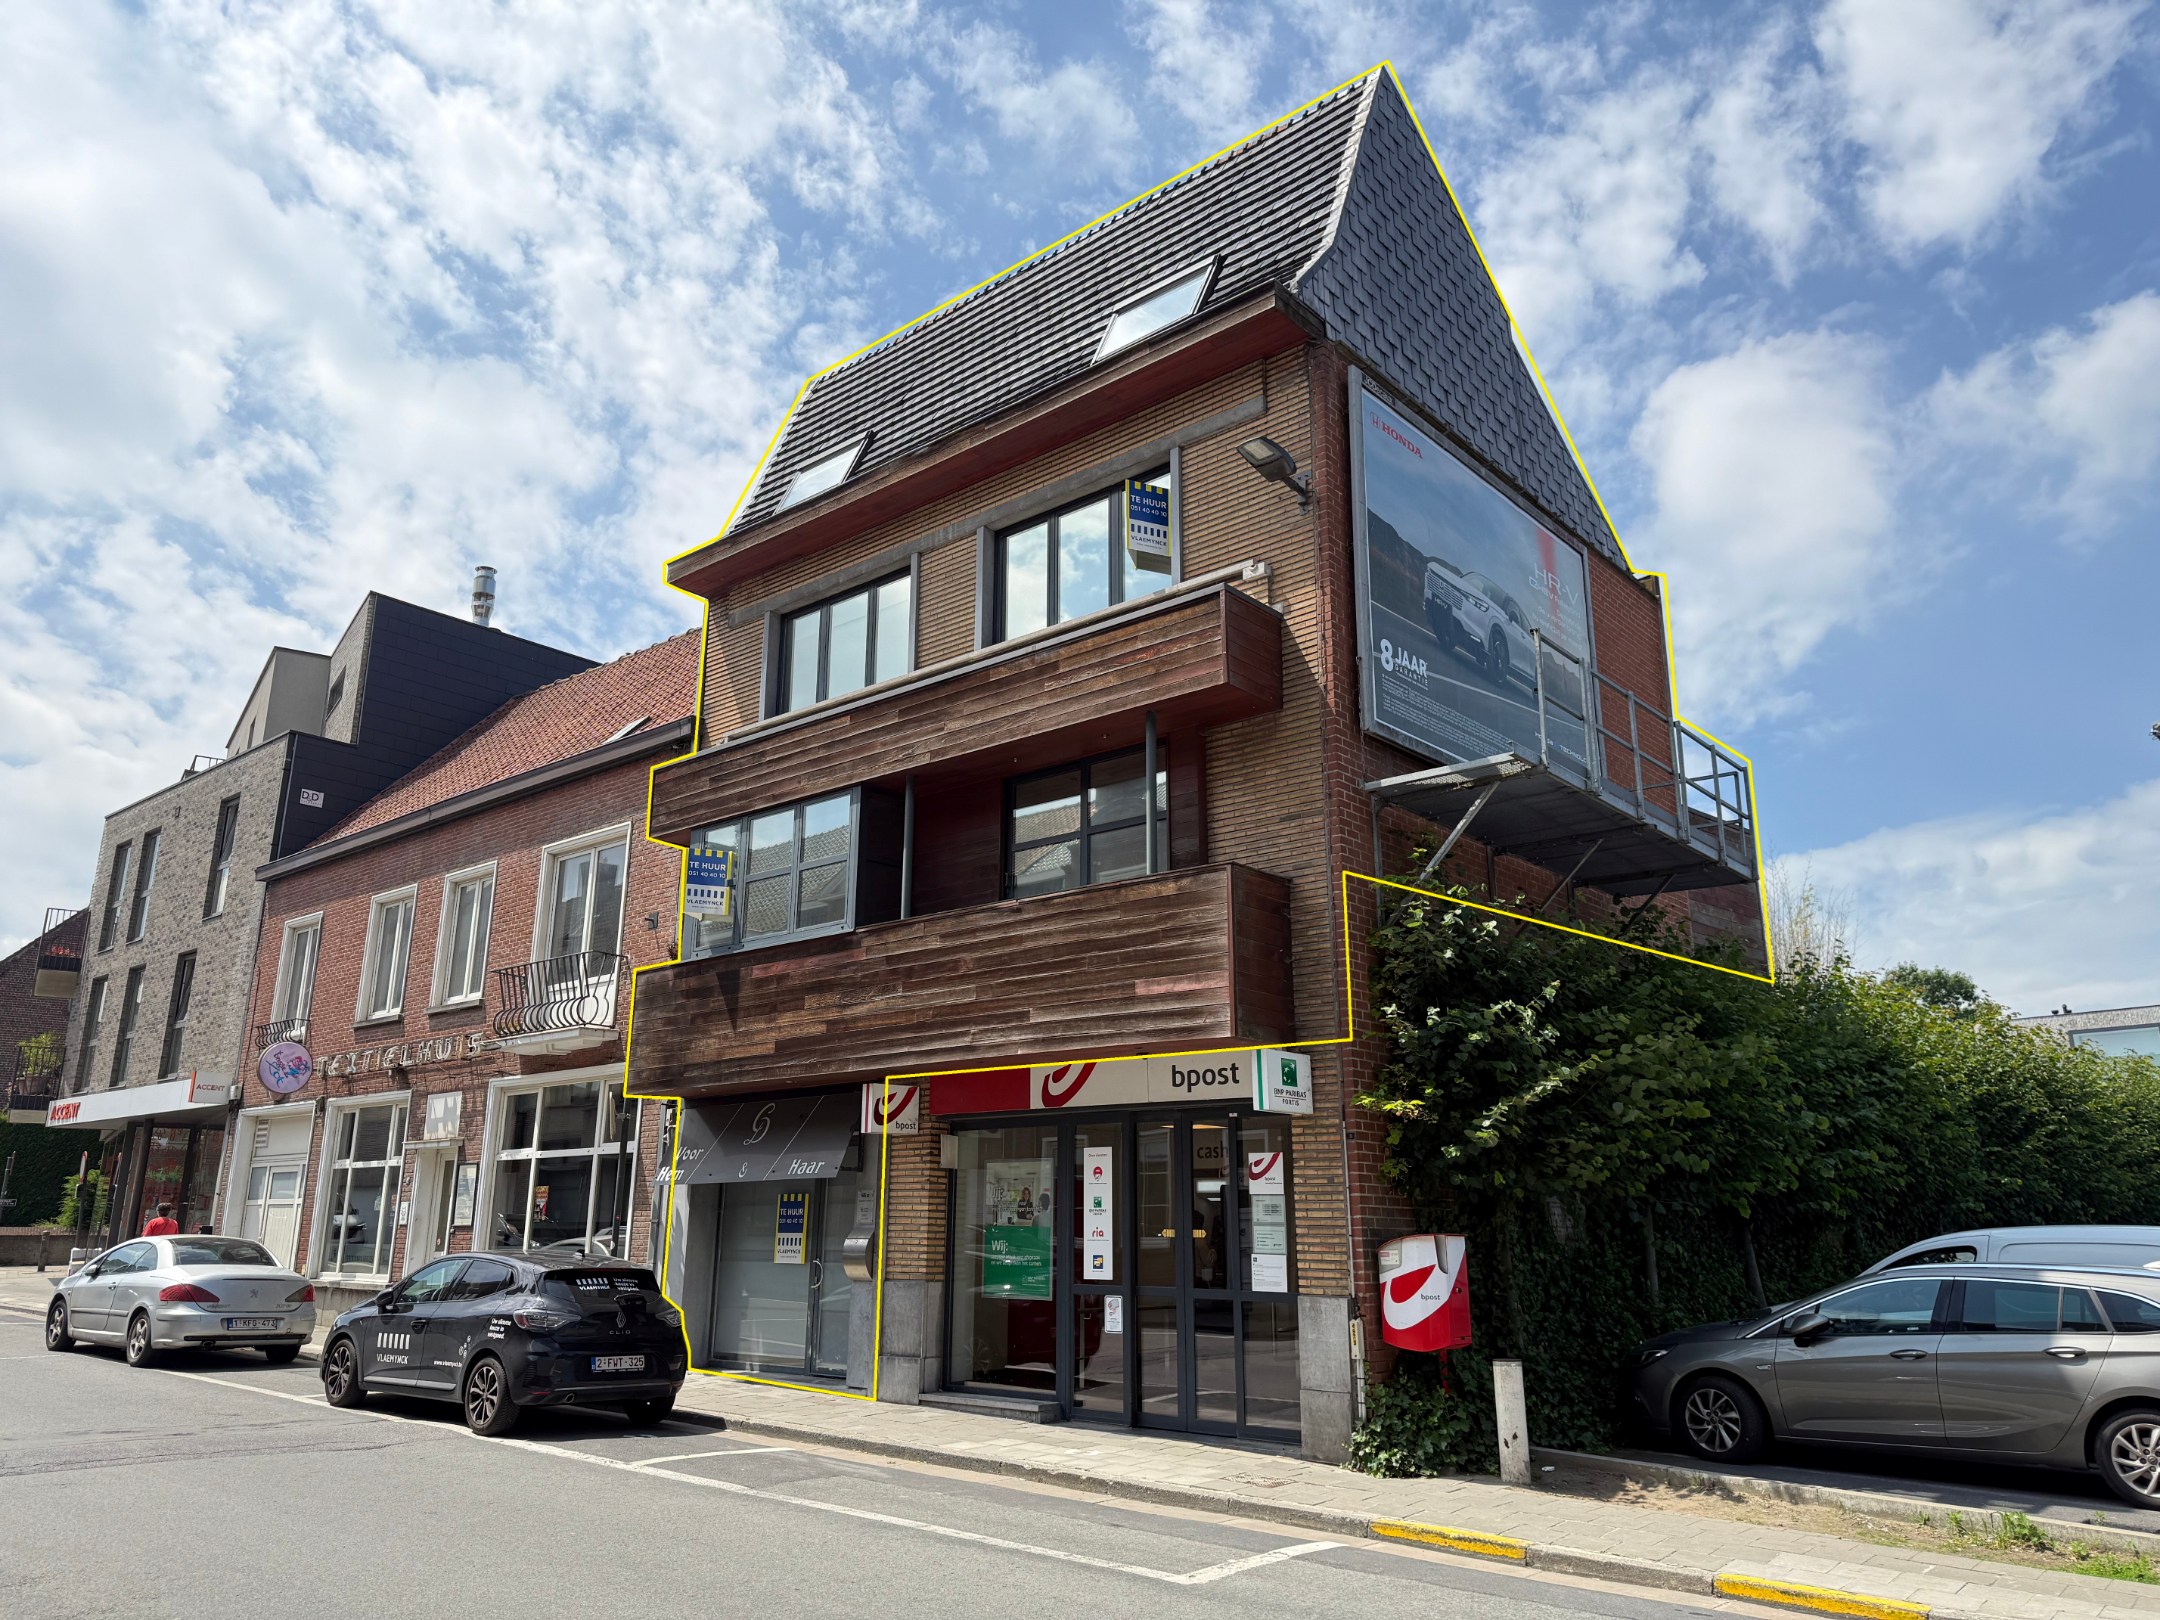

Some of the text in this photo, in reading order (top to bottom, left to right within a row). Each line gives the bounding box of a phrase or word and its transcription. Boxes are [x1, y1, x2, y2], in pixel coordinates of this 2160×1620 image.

[1381, 421, 1424, 459] HONDA
[1130, 495, 1167, 509] TE HUUR
[1130, 535, 1168, 546] VLAEMYNCK
[1534, 562, 1579, 605] HR-V
[1380, 638, 1428, 678] 8 JAAR
[1394, 663, 1428, 687] GARANTIE
[689, 861, 727, 871] TE HUUR
[686, 898, 724, 906] VLAEMYNCK
[1171, 1062, 1240, 1093] bpost
[196, 1083, 226, 1092] ACCENT
[1273, 1087, 1307, 1098] BNP PARIBAS
[1282, 1098, 1300, 1107] FORTIS
[50, 1102, 81, 1121] ACCENT
[895, 1121, 917, 1131] bpost
[676, 1146, 705, 1161] Voor
[1196, 1140, 1229, 1159] cash
[738, 1161, 748, 1178] &
[787, 1158, 826, 1175] Haar
[780, 1208, 804, 1216] TE HUUR
[1091, 1226, 1105, 1238] ria
[991, 1240, 1008, 1254] Wij:
[1420, 1294, 1441, 1302] bpost
[234, 1319, 275, 1327] 1-KFG-473
[376, 1354, 409, 1365] VLAEMYNCK
[597, 1357, 644, 1368] 2-FWT-325
